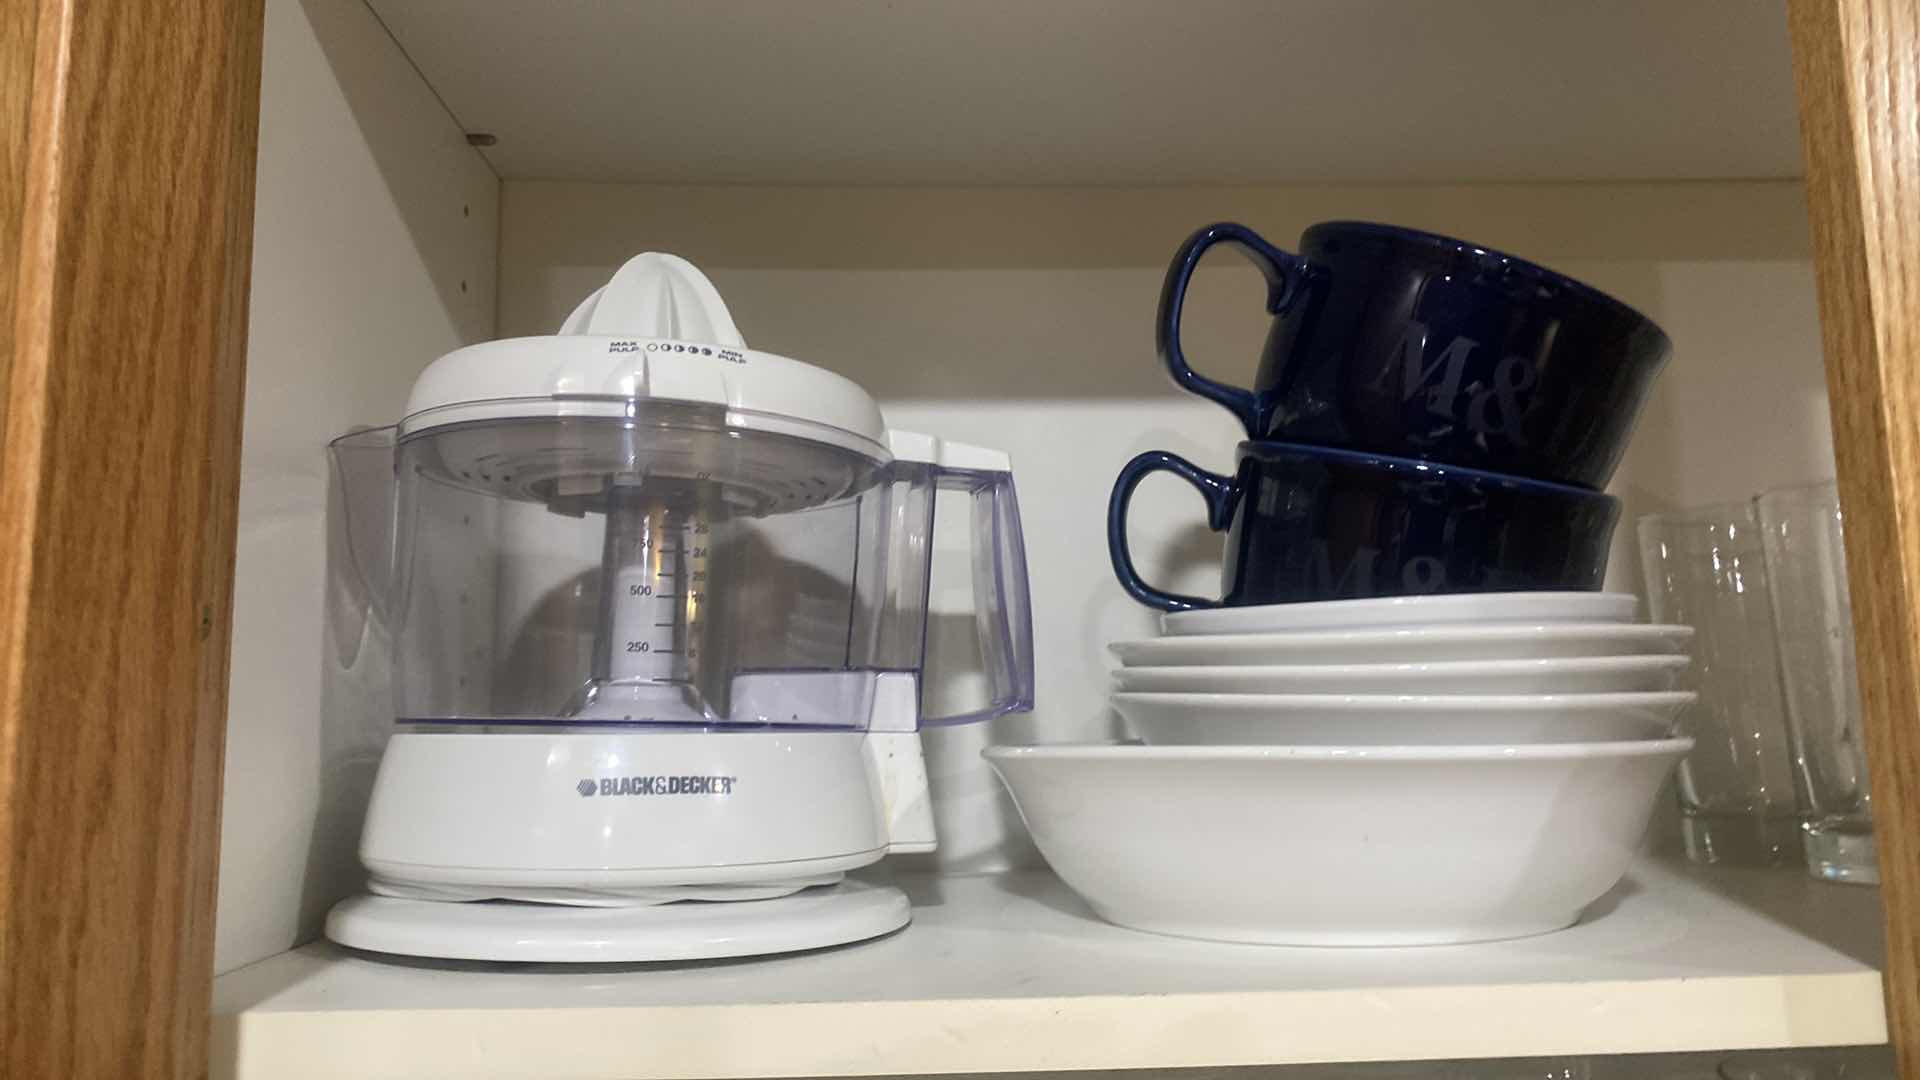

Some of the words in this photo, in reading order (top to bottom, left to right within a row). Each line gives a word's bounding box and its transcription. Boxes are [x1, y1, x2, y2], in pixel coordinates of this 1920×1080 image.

[717, 353, 747, 364] PULP
[721, 349, 743, 358] MIN
[630, 584, 652, 597] 500
[626, 640, 649, 653] 250
[600, 776, 732, 796] BLACK&DECKER
